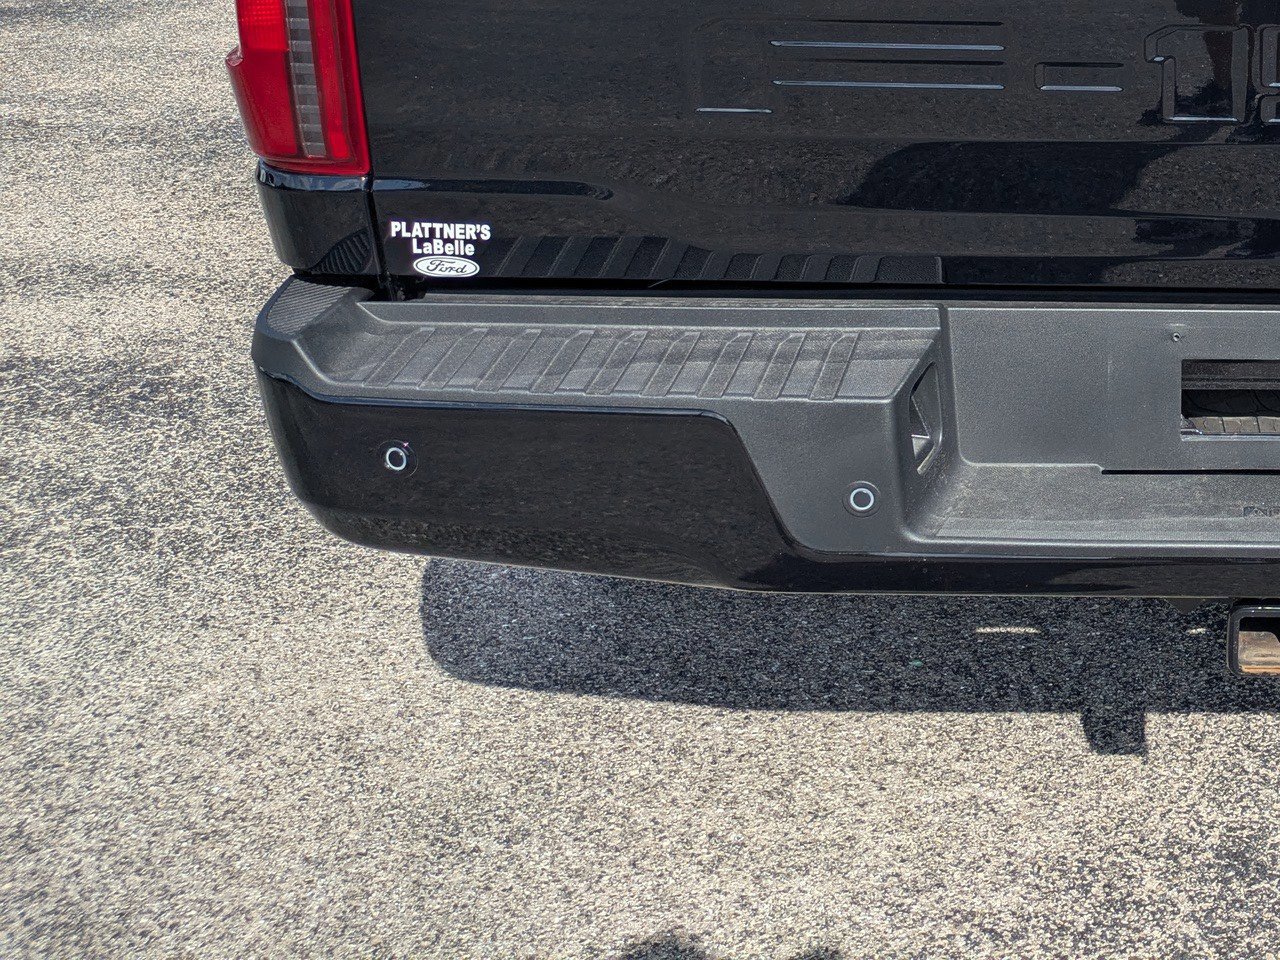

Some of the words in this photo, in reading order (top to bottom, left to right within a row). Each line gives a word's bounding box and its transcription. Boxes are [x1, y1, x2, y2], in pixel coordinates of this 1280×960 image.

[390, 221, 491, 240] PLATTNER'S
[412, 238, 475, 256] LaBelle
[426, 259, 468, 274] Ford
